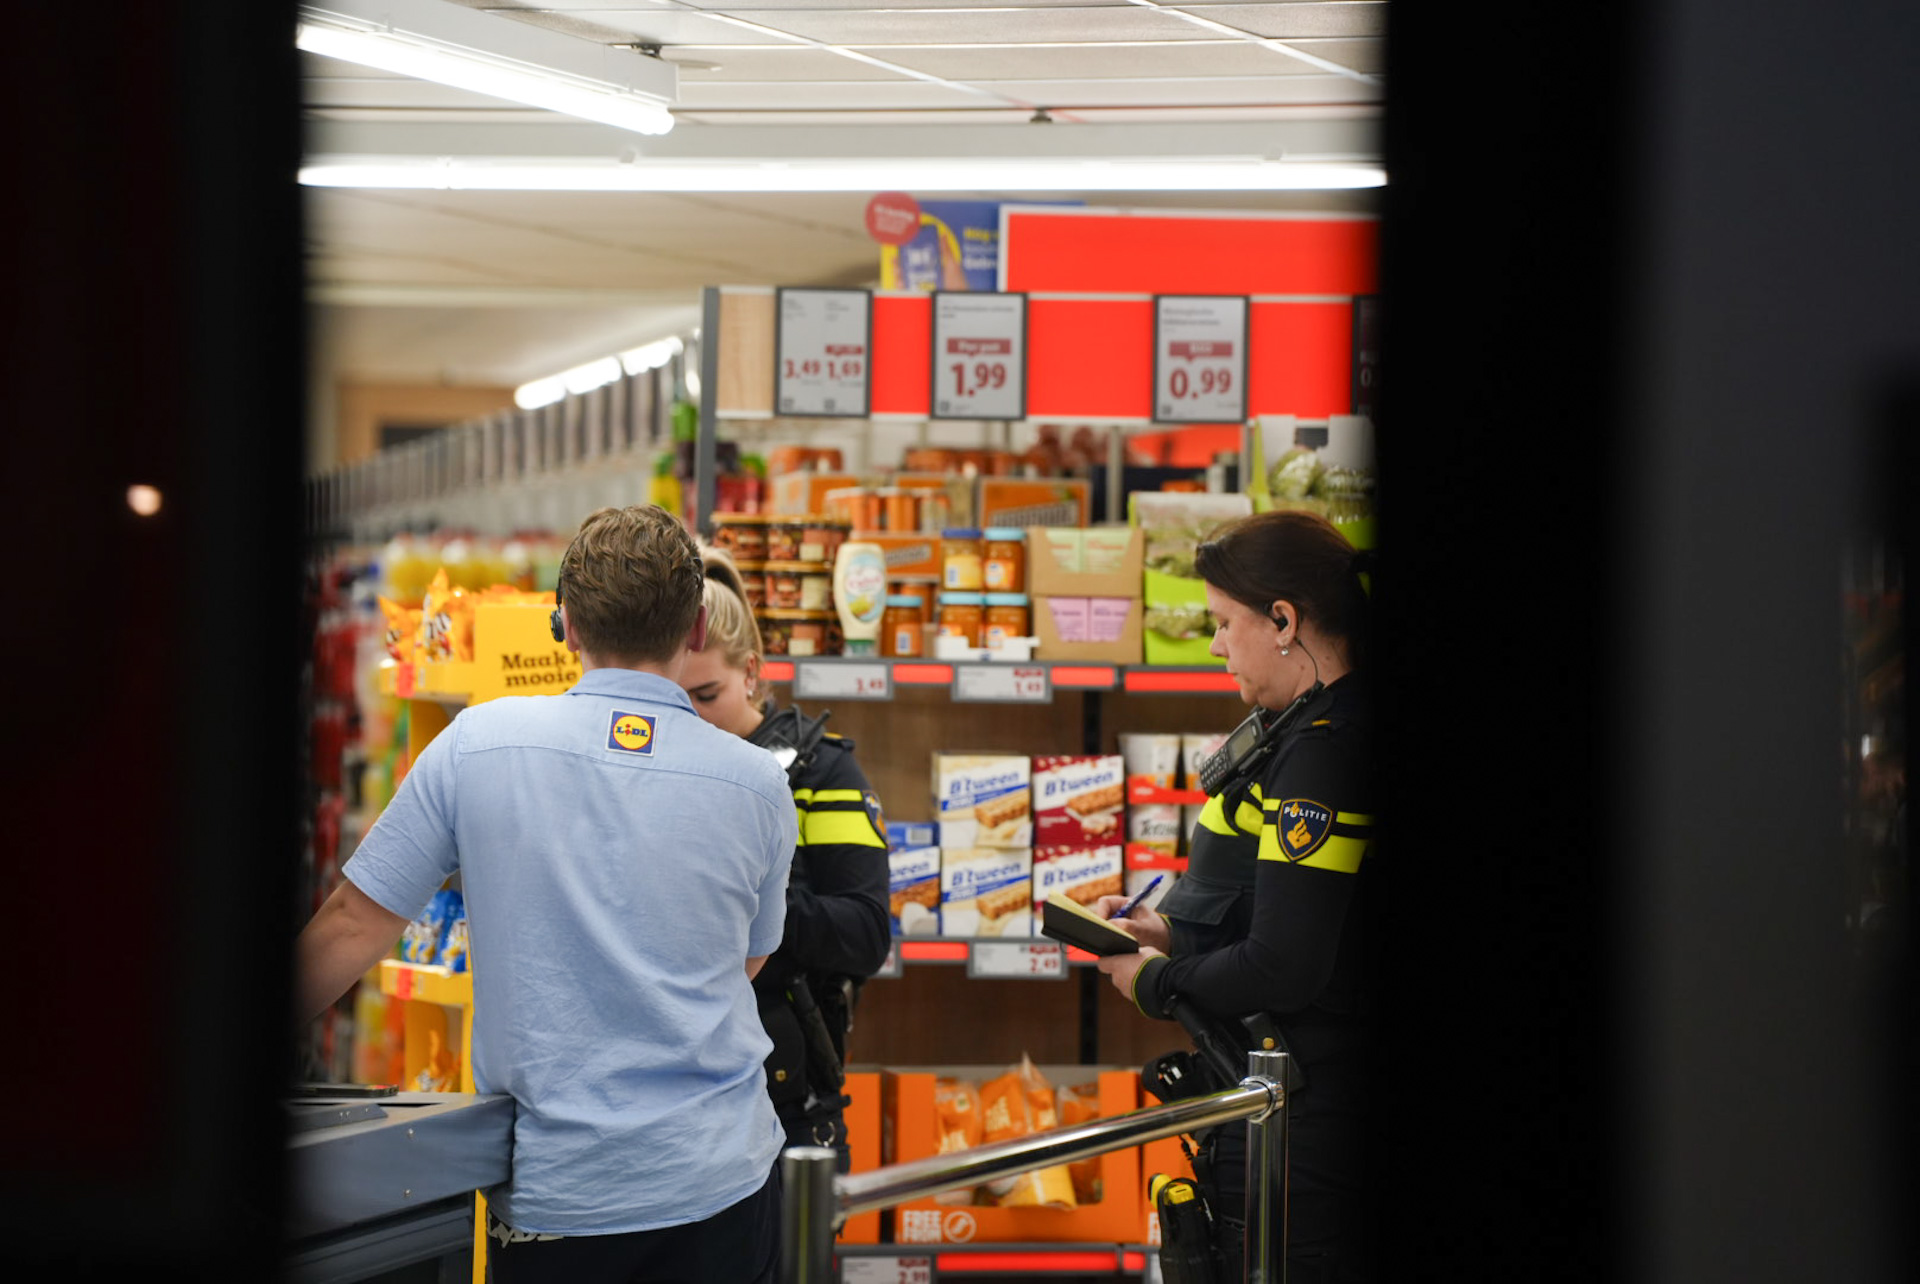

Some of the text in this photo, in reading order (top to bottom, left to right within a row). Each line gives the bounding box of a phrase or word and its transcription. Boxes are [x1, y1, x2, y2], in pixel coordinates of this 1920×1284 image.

[784, 359, 820, 379] 3.49
[952, 362, 1007, 397] 1.99
[1170, 367, 1232, 400] 0.99
[502, 650, 567, 670] Maak
[950, 771, 1020, 795] B'tween
[1044, 771, 1114, 796] B'tween
[1284, 805, 1328, 822] POLITIE
[952, 862, 1021, 887] B'tween
[1043, 861, 1112, 887] B'tween
[902, 1210, 942, 1225] FREE
[902, 1226, 942, 1242] FROM
